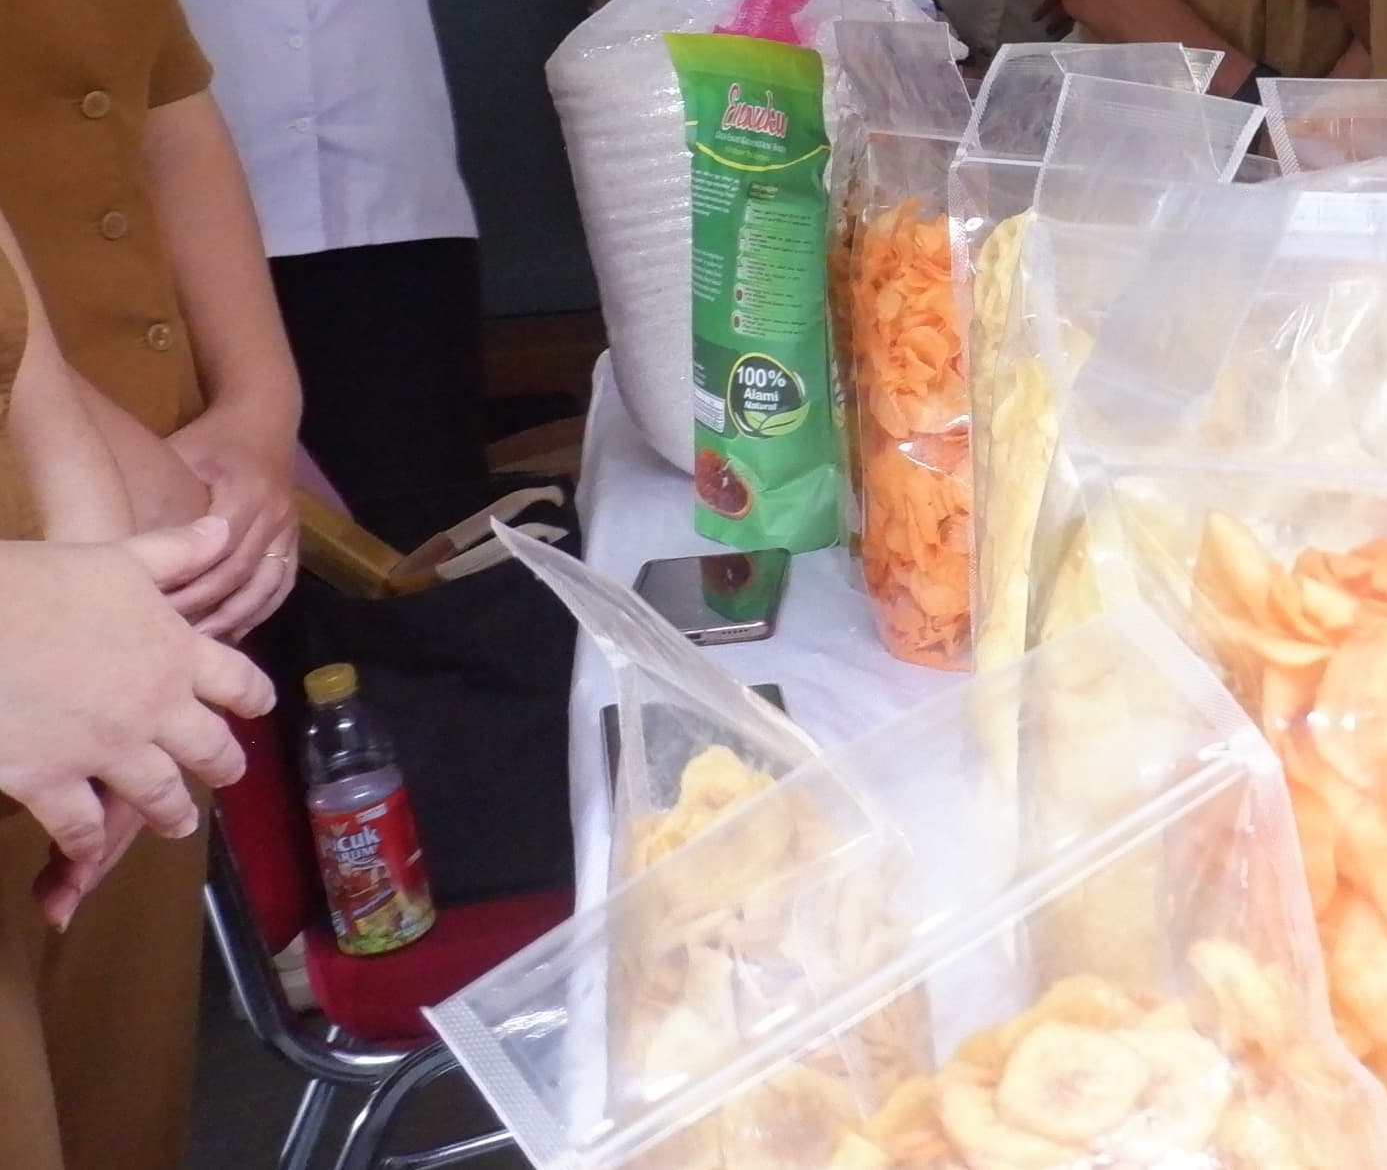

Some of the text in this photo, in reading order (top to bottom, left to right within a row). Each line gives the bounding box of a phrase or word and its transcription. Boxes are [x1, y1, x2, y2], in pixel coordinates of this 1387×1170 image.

[737, 365, 787, 388] 100%
[744, 388, 779, 401] Alami
[744, 401, 777, 411] Natural
